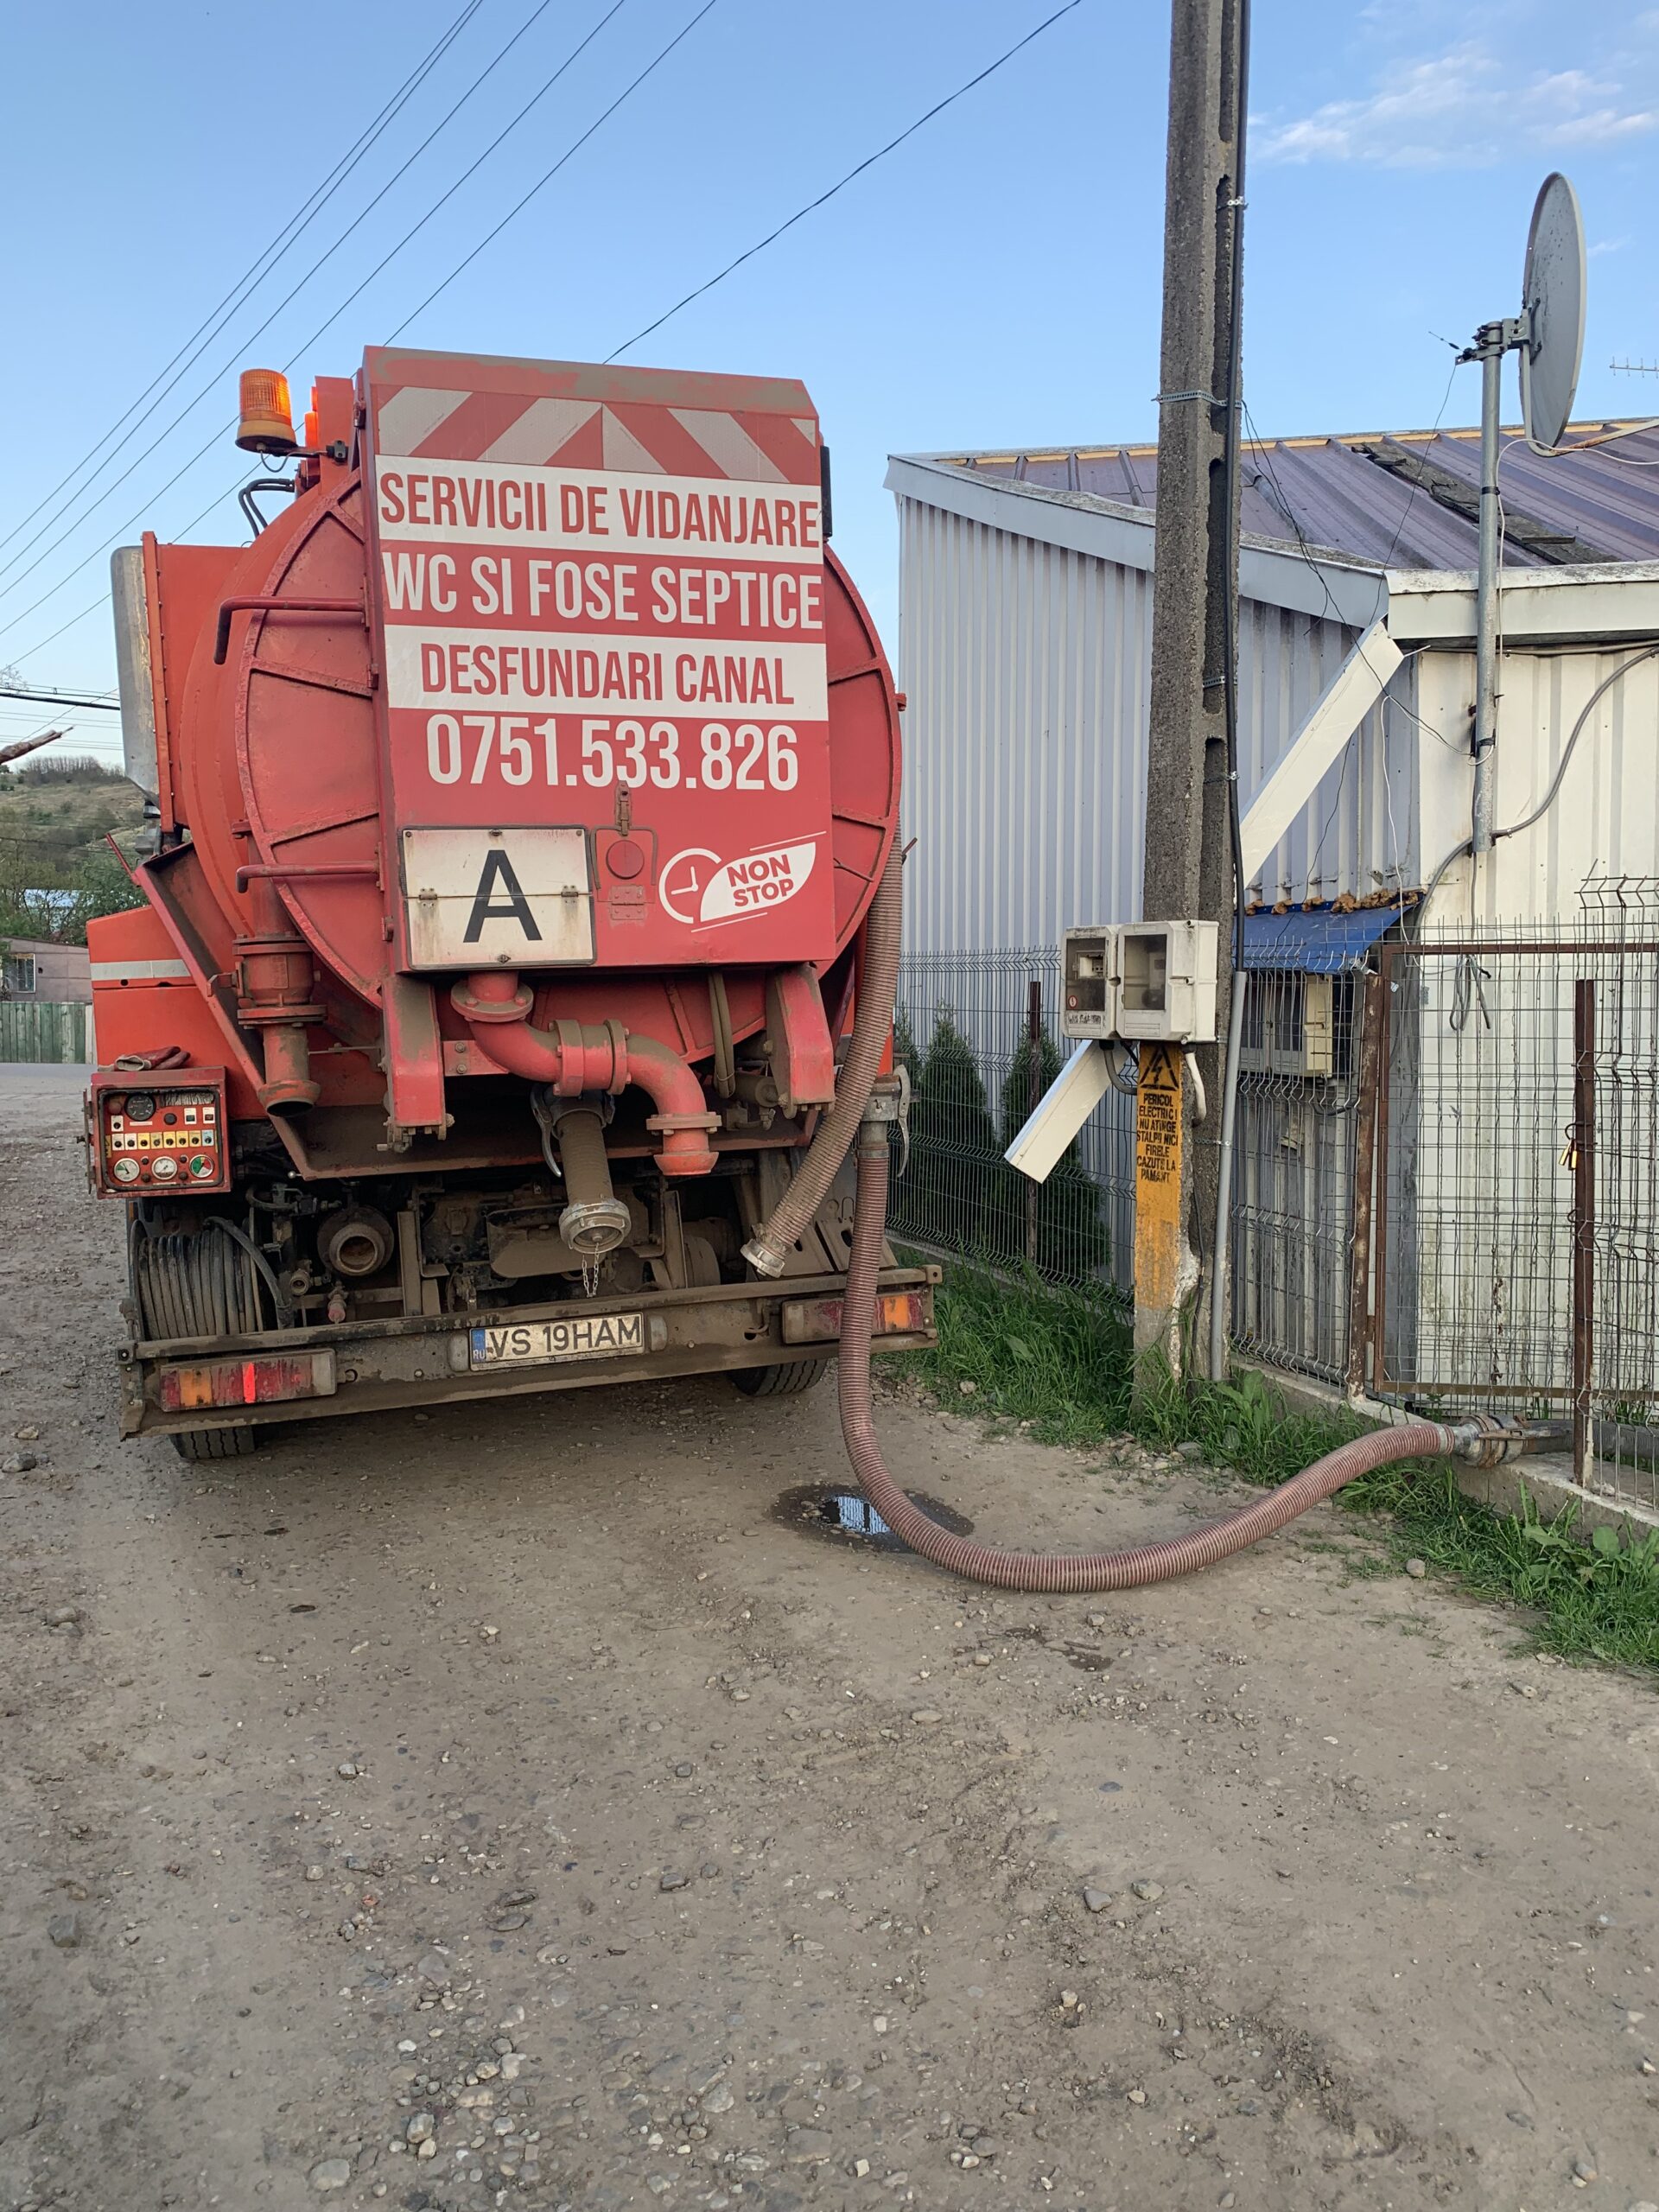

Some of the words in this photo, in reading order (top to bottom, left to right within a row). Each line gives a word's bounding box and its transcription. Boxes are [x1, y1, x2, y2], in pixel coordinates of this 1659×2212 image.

[380, 472, 546, 531] SERVICII
[561, 485, 609, 535] DE
[620, 488, 820, 549] VIDANJARE
[383, 551, 457, 613] WC
[471, 556, 513, 614] SI
[529, 560, 639, 621] FOSE
[651, 565, 823, 630] SEPTICE
[421, 643, 663, 701] DESFUNDARI
[675, 653, 795, 704] CANAL
[426, 713, 798, 791] 0751.533.826
[726, 853, 791, 888] NON
[462, 849, 543, 944] A
[732, 878, 795, 909] STOP
[1143, 1093, 1173, 1107] PERICOL
[1140, 1118, 1150, 1130] NU
[1164, 1135, 1179, 1147] NICI
[1146, 1144, 1170, 1158] FIRELE
[1166, 1160, 1176, 1172] LA
[489, 1329, 531, 1358] VS
[543, 1317, 640, 1352] 19HAM
